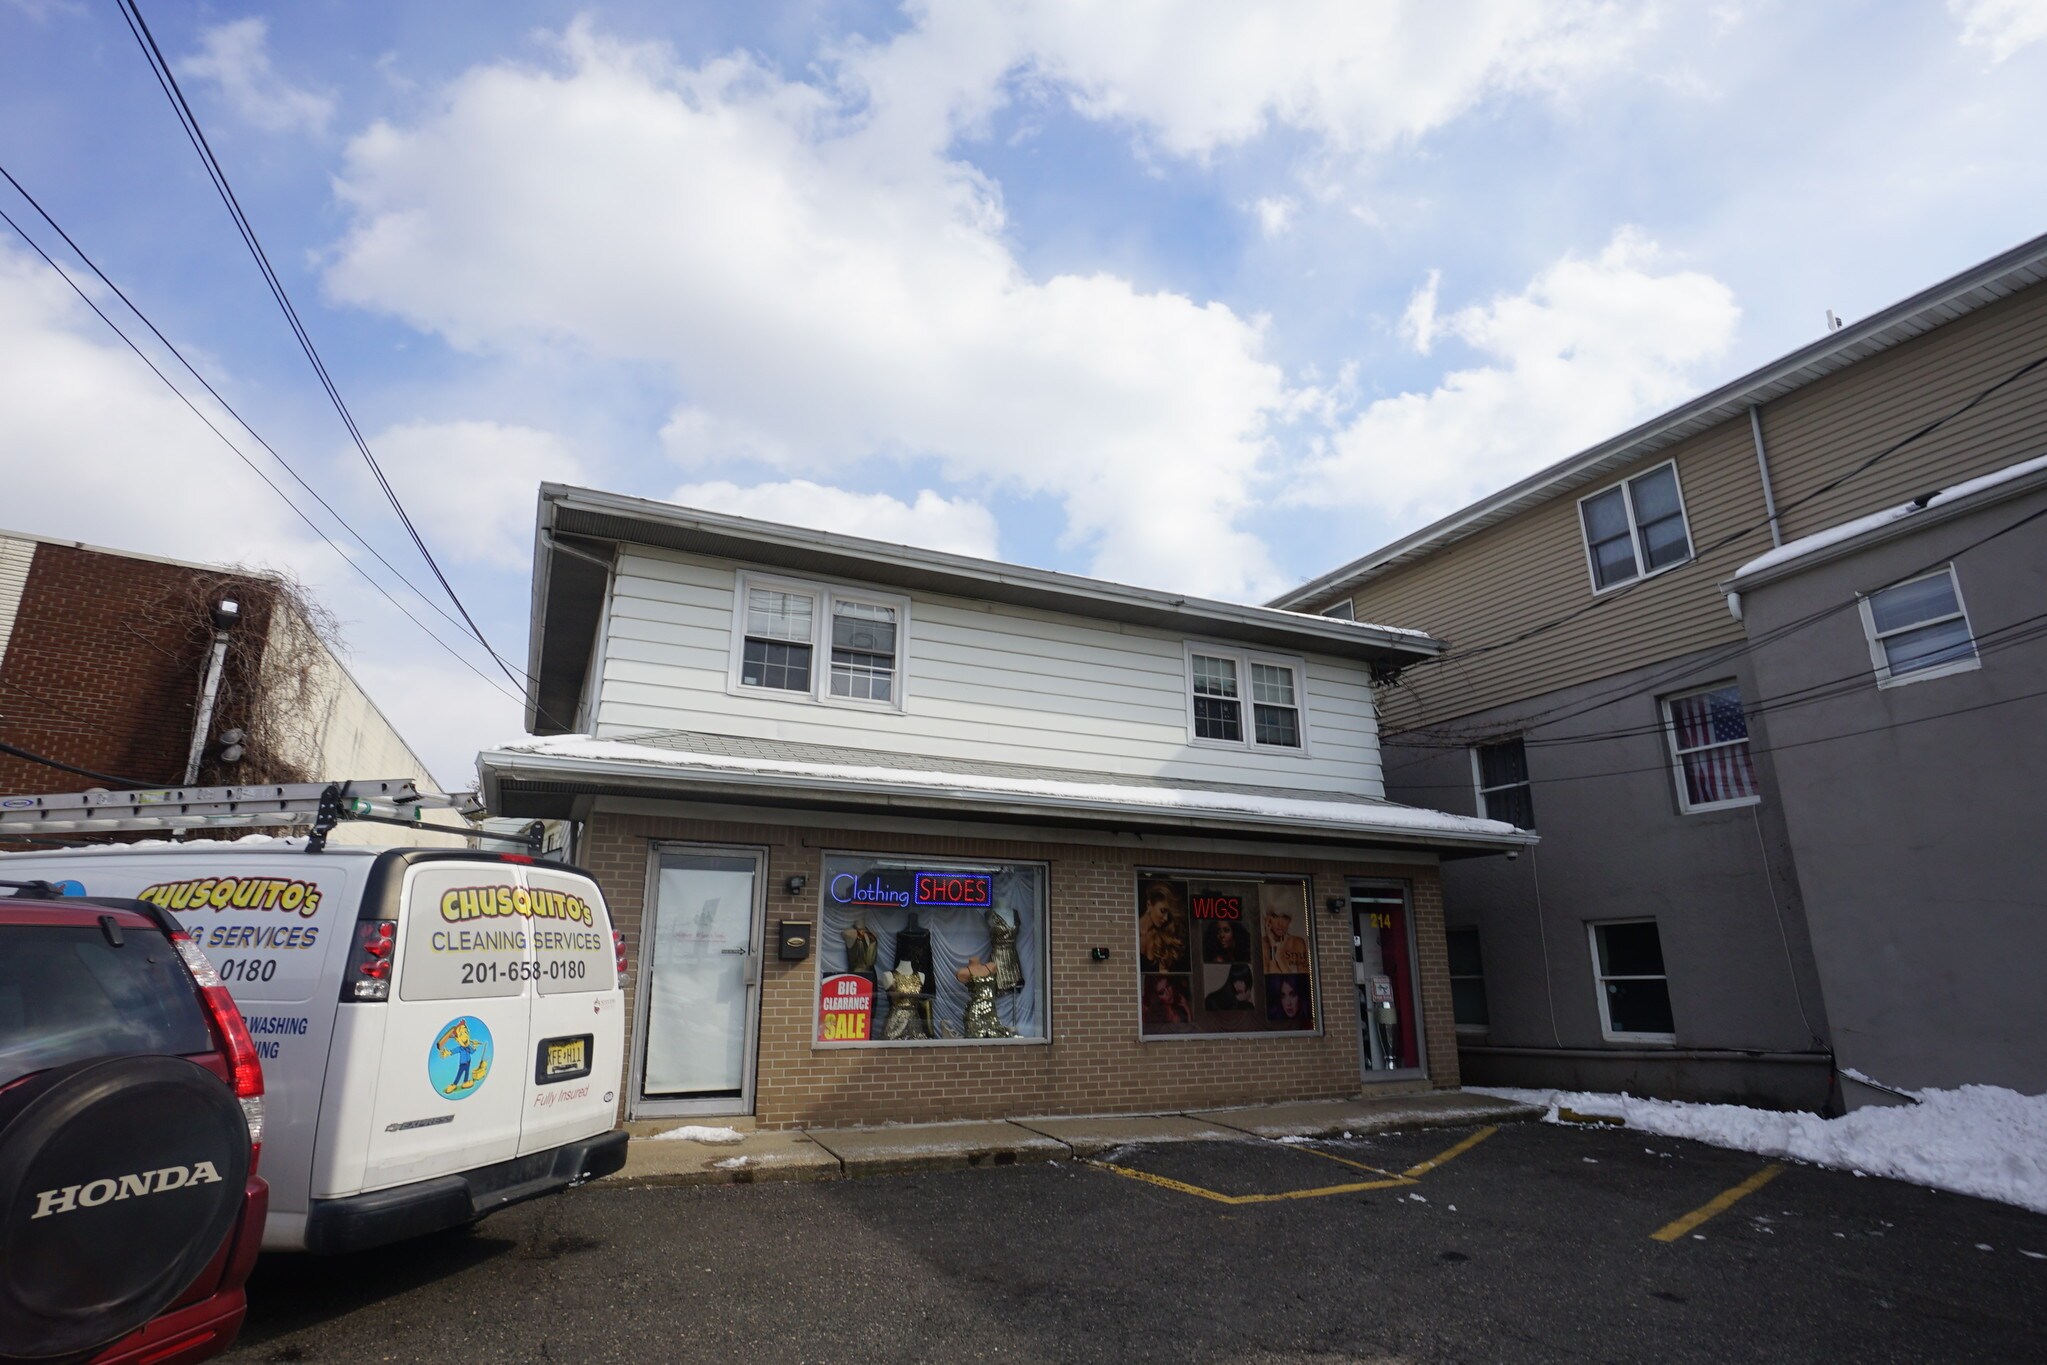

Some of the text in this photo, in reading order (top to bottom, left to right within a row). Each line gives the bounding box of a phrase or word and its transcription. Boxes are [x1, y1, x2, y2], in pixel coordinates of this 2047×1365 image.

[830, 873, 987, 907] Clothing SHOES
[1193, 897, 1239, 920] WIGS
[1370, 913, 1391, 929] 214
[207, 926, 319, 949] SERVICES
[431, 931, 601, 952] CLEANING SERVICES
[461, 960, 586, 984] 201-658-0180
[837, 980, 857, 996] BIG
[823, 996, 870, 1011] CLEARANCE
[249, 1016, 308, 1035] WASHING
[823, 1013, 866, 1039] SALE
[534, 1084, 589, 1107] Fully Insured
[31, 1161, 222, 1219] HONDA
